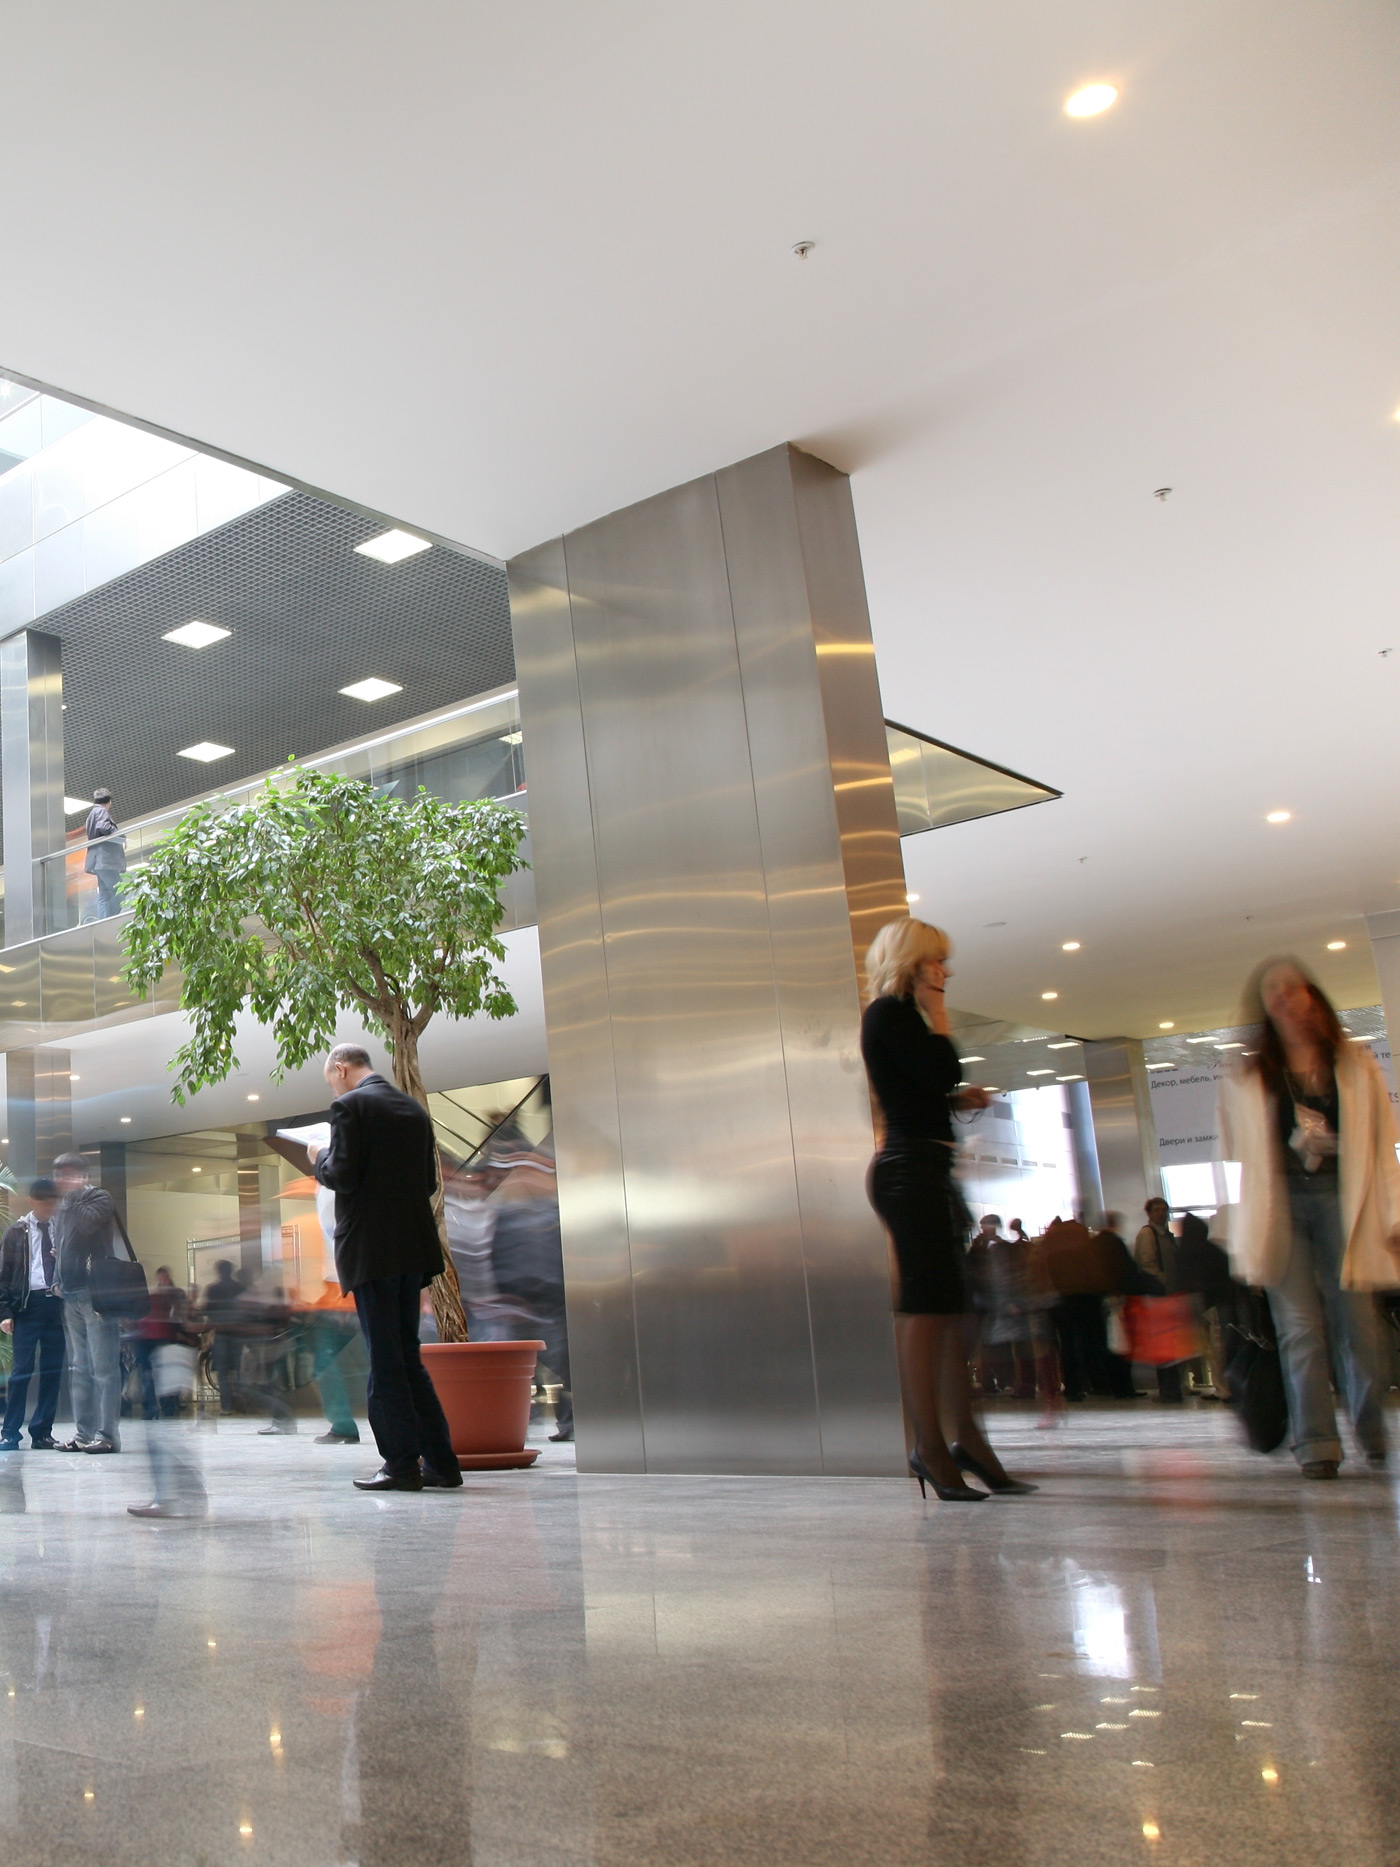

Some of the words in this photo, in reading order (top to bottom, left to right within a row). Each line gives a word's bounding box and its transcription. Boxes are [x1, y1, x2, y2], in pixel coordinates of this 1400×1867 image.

[1151, 1080, 1178, 1089] Декор,
[1180, 1075, 1212, 1084] мебель,
[1159, 1138, 1185, 1147] Двери
